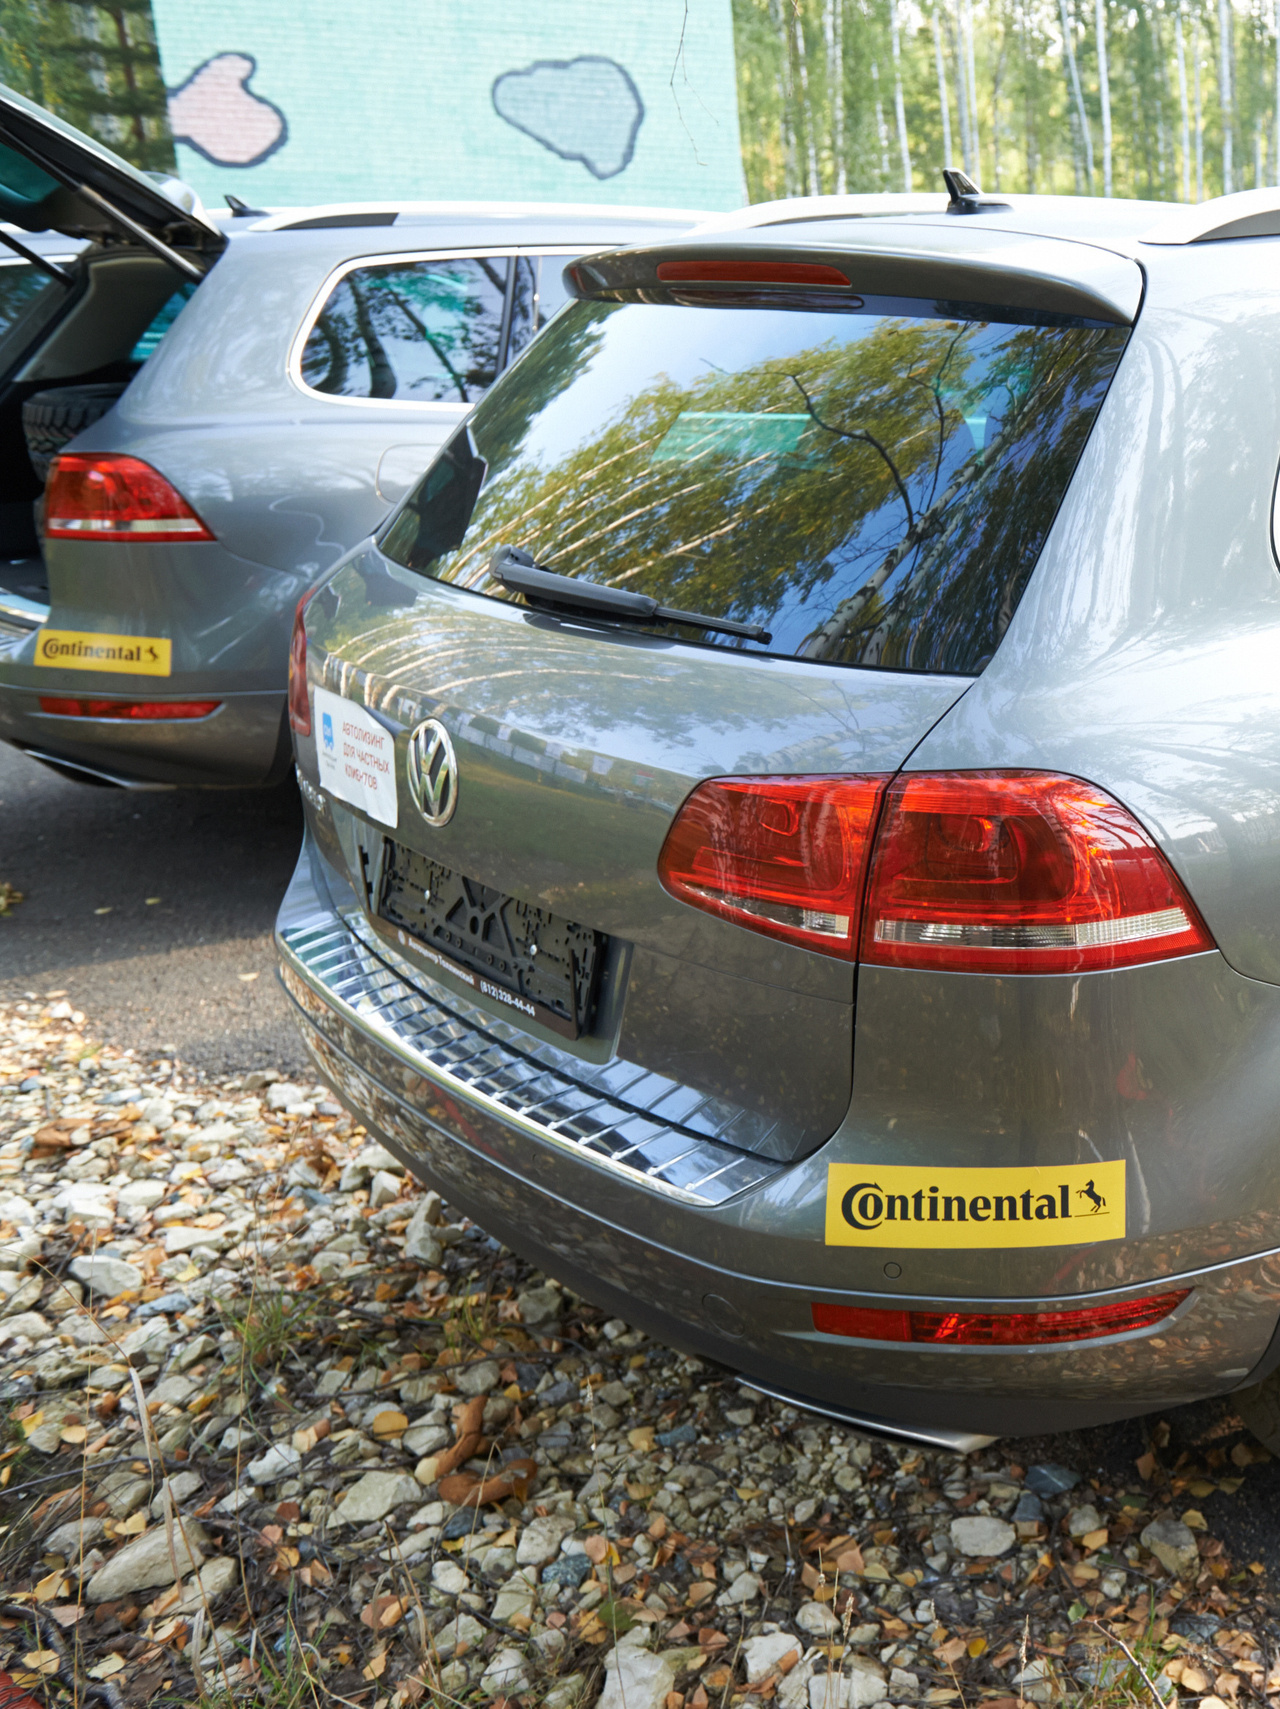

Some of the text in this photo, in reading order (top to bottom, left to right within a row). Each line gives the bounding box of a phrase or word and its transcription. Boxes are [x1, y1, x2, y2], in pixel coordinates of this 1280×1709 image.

[42, 638, 141, 662] Continental
[342, 721, 385, 751] АВТОЛИЗИНГ
[343, 742, 356, 759] ДЛЯ
[356, 748, 390, 774] ЧАСТНЫХ
[841, 1181, 1073, 1231] Continental
